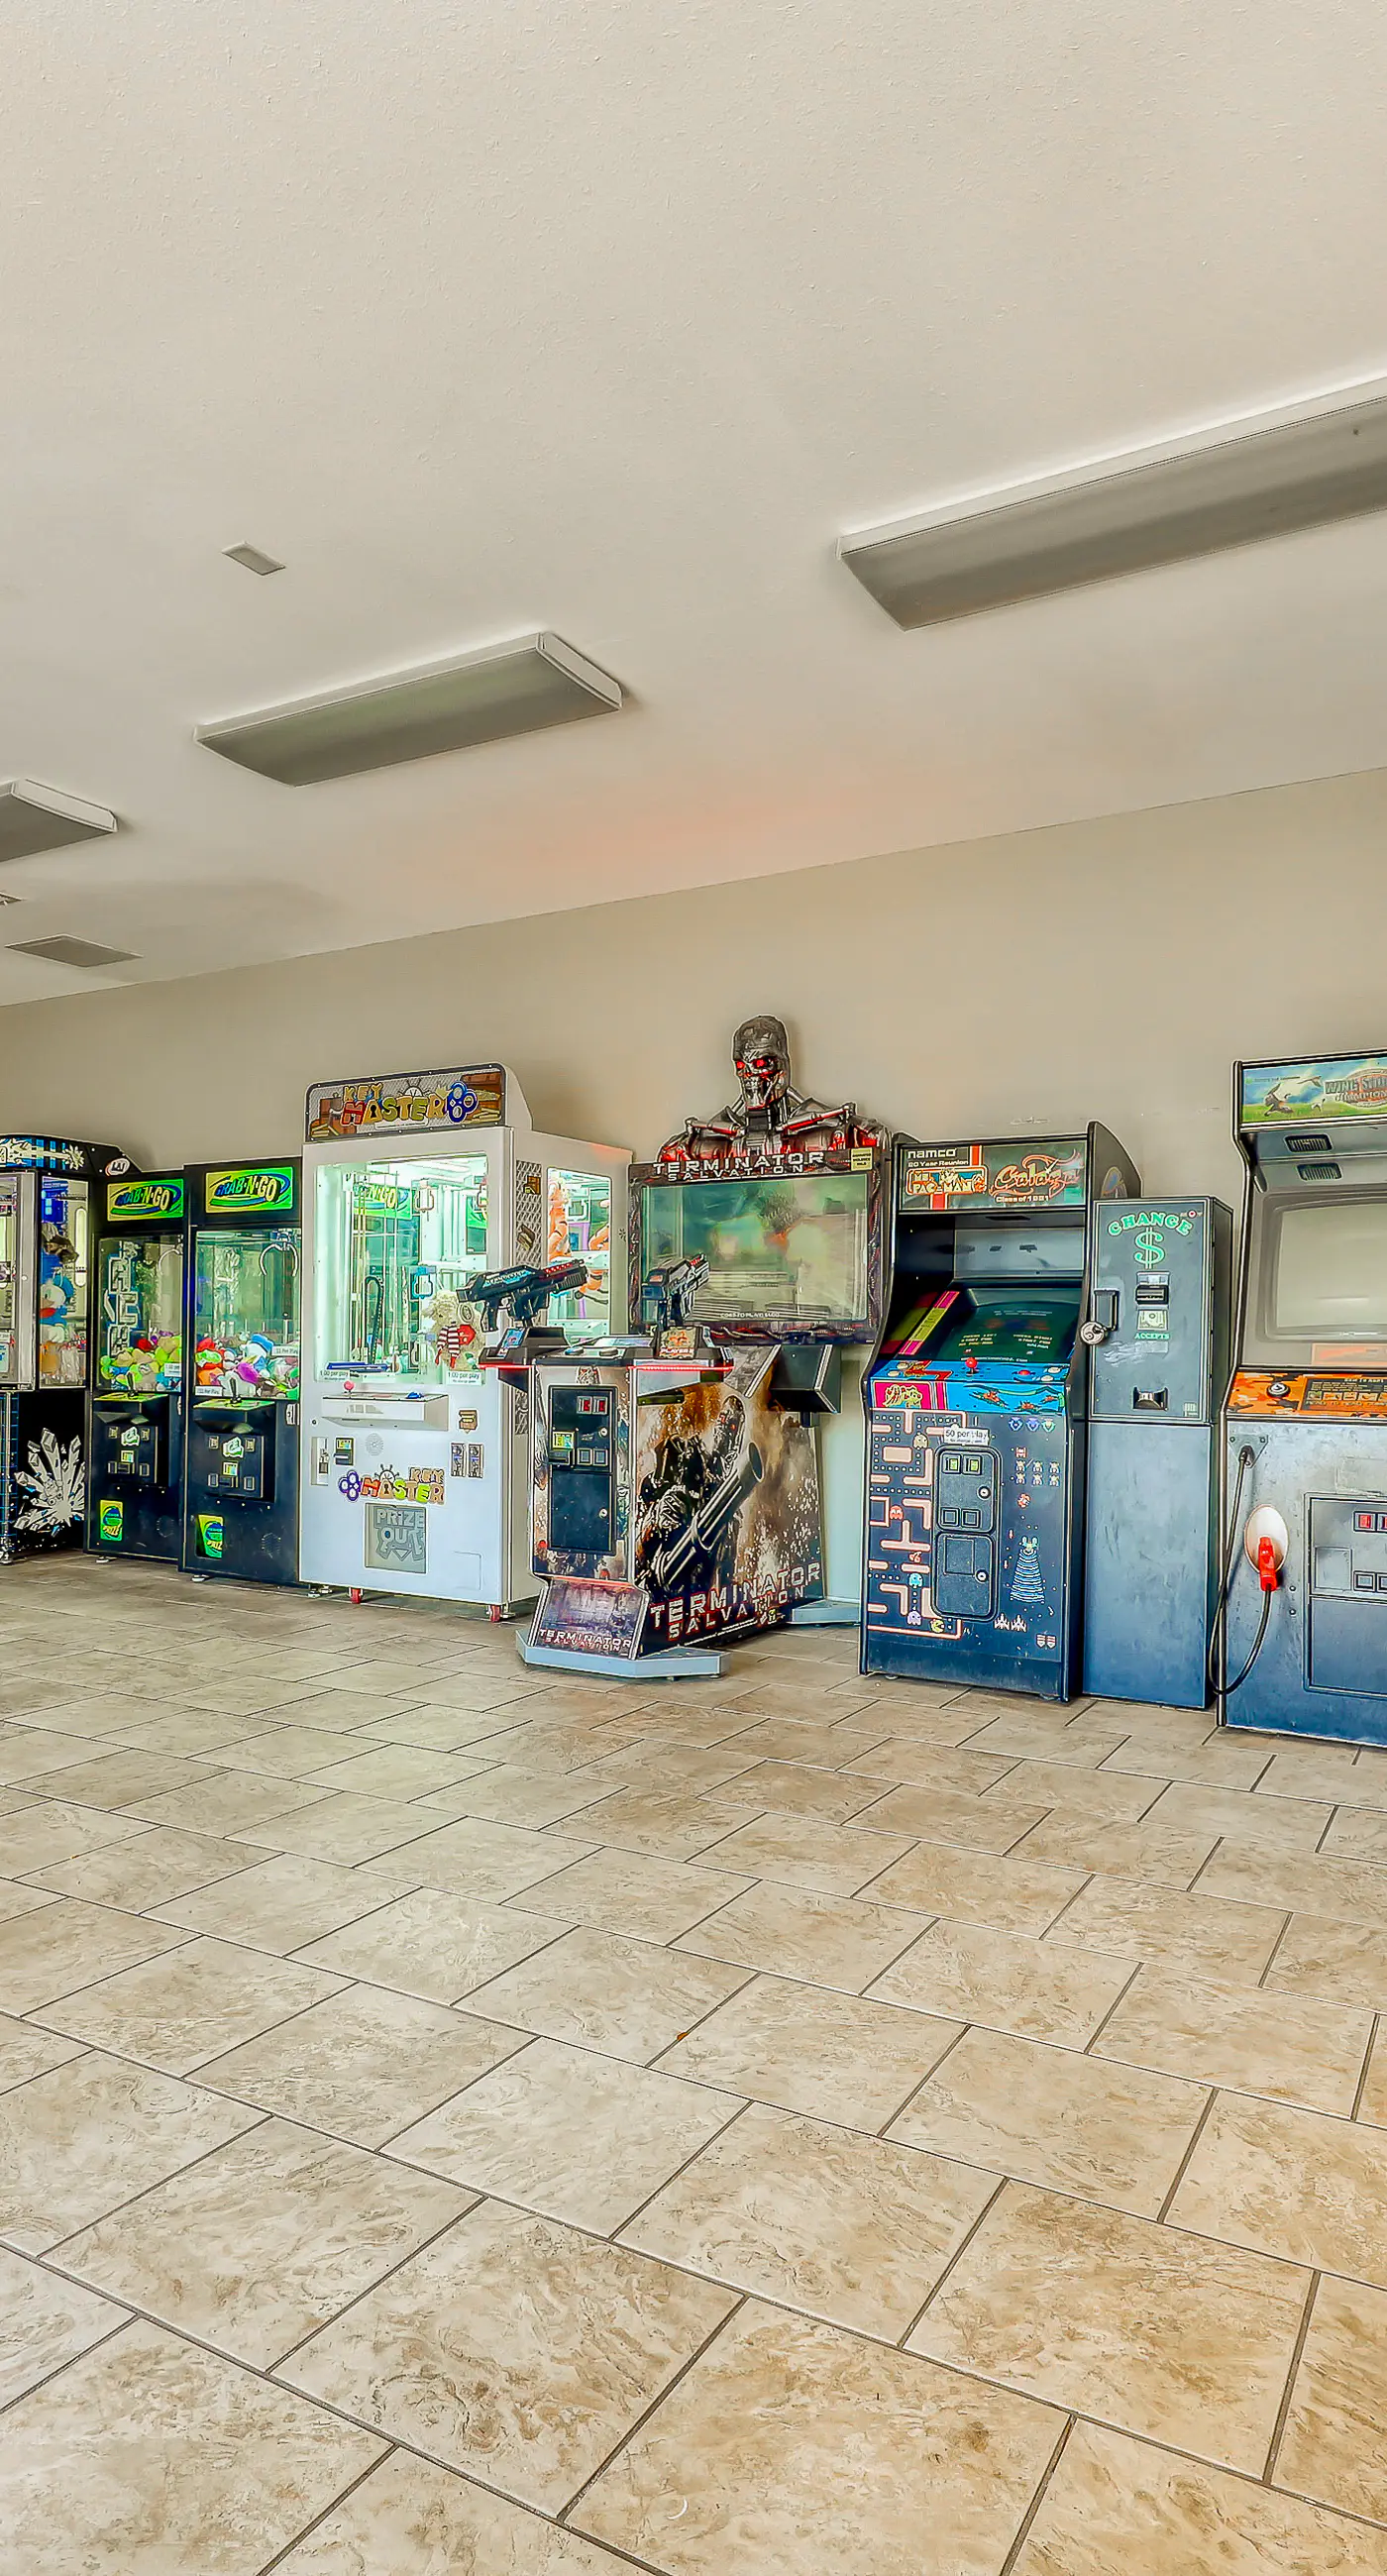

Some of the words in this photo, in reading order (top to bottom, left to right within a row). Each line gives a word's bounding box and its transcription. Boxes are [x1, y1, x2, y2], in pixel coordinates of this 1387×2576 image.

[343, 1082, 384, 1103] KEY
[341, 1094, 449, 1127] MASTER
[653, 1151, 824, 1175] TERMINATOR
[907, 1148, 957, 1159] namco
[668, 1164, 803, 1182] SALVATION
[1108, 1211, 1193, 1236] CHANGE
[409, 1466, 445, 1484] KEY
[361, 1476, 445, 1504] MASTER
[650, 1561, 820, 1629] TERMINATOR
[668, 1585, 804, 1640] SALVATION
[539, 1628, 632, 1649] TERMINATOR
[545, 1637, 620, 1652] SALVATION
